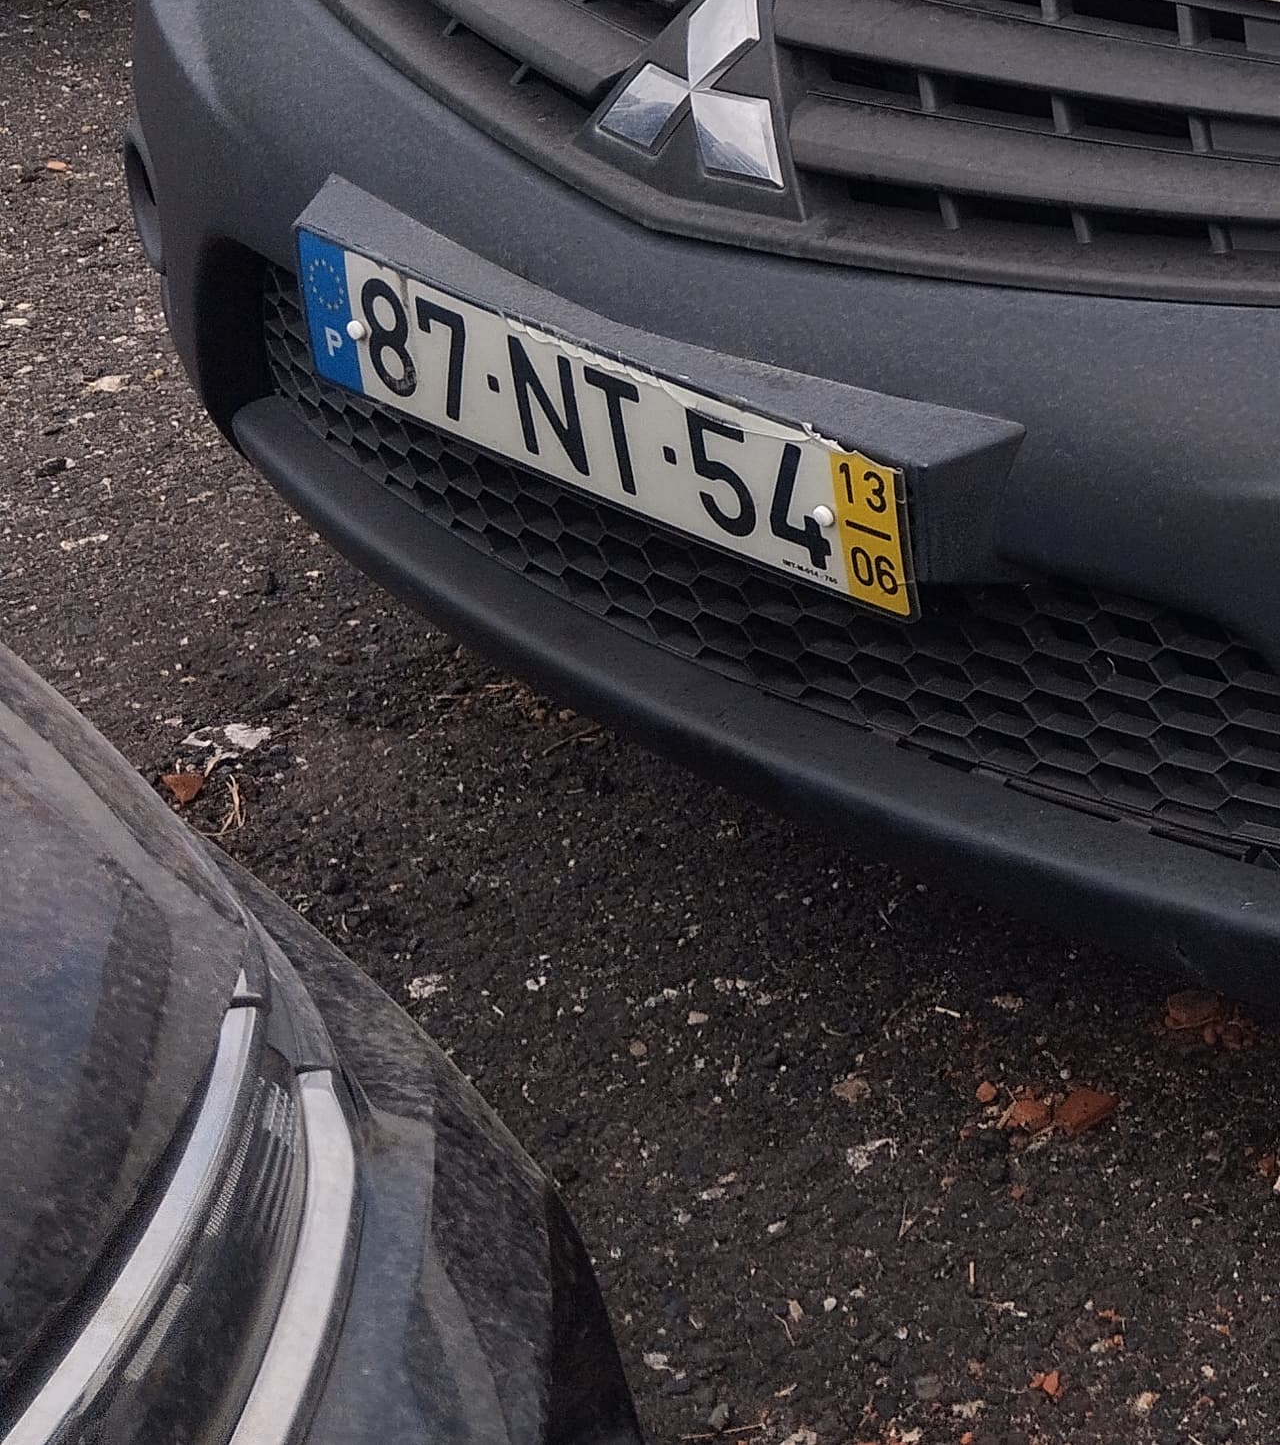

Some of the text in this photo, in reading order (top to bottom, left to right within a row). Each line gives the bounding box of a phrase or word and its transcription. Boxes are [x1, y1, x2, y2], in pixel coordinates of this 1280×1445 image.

[324, 327, 343, 357] P
[839, 461, 888, 514] 13
[850, 545, 899, 596] 06
